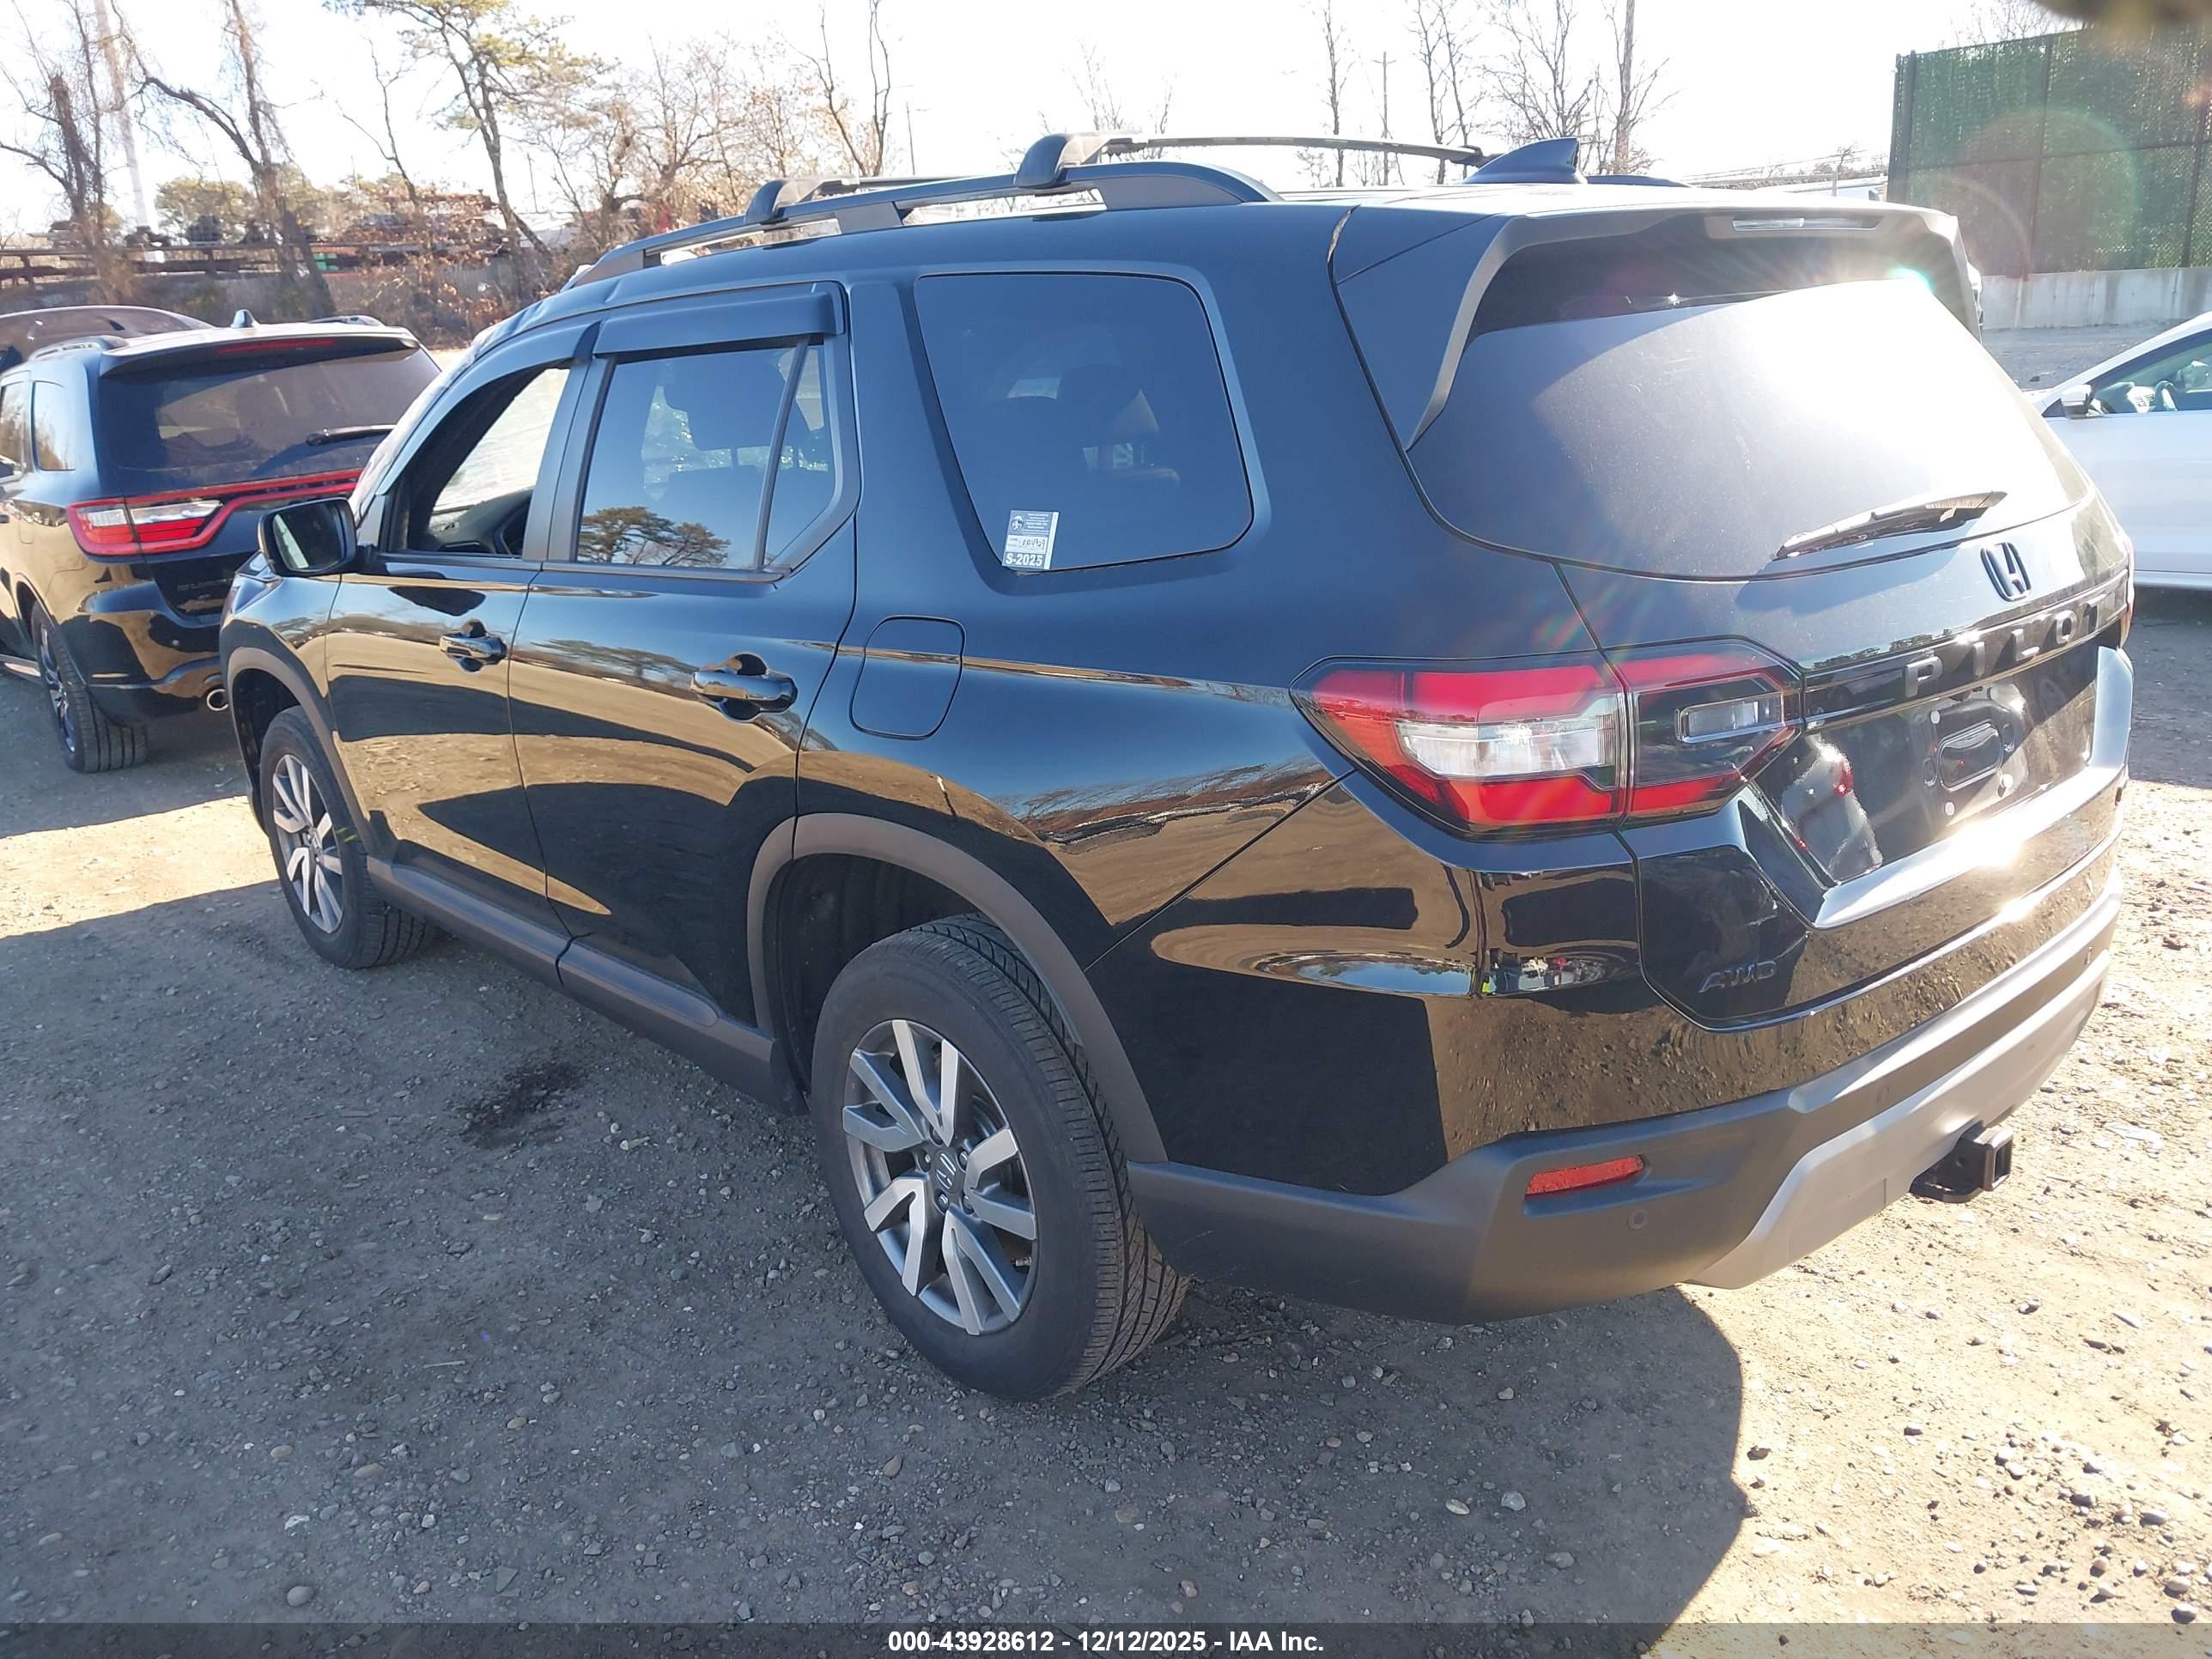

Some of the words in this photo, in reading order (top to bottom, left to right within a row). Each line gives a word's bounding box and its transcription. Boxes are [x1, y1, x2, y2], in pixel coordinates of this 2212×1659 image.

[1006, 552, 1043, 567] S-2025
[1905, 593, 2108, 698] PILOT
[1698, 960, 1777, 994] AWD
